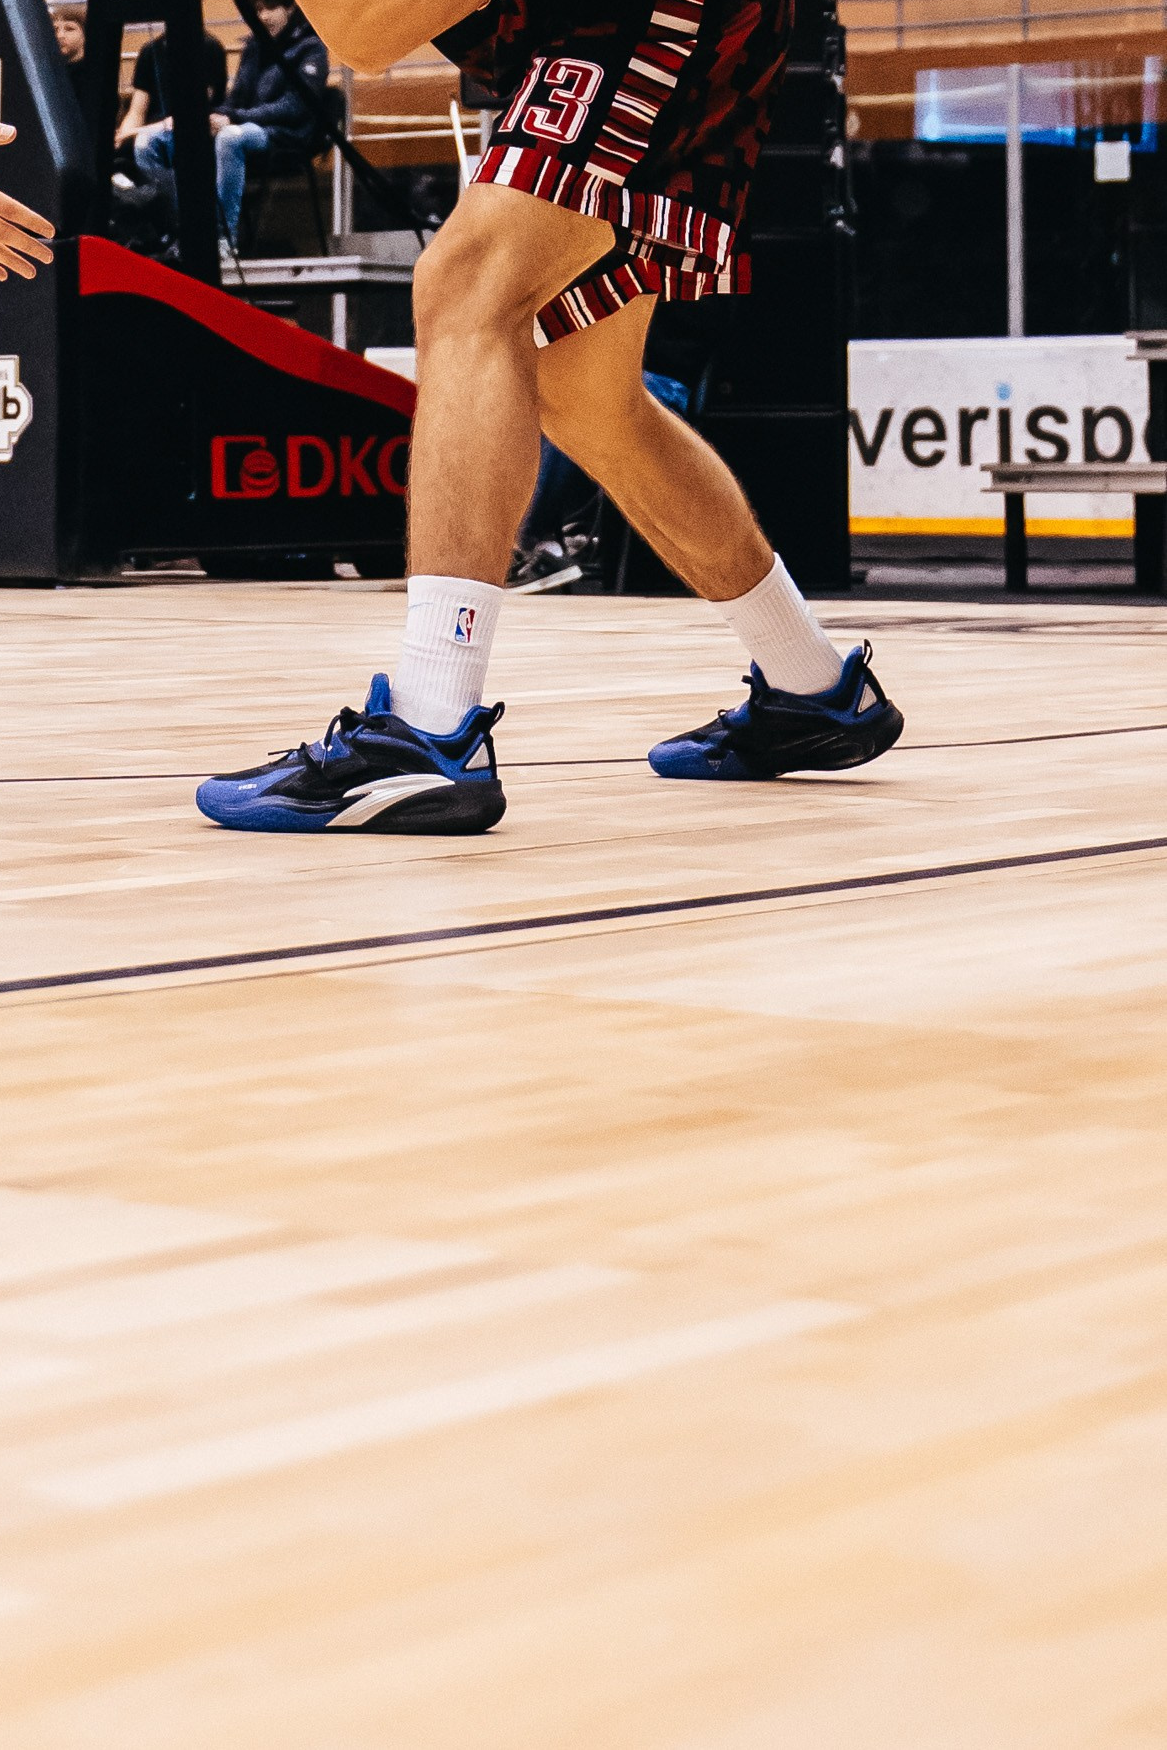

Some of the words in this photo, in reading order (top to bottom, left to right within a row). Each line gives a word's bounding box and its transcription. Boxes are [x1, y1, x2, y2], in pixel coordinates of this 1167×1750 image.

[499, 57, 605, 144] 13
[286, 434, 412, 498] DKC
[847, 381, 1149, 466] verisp
